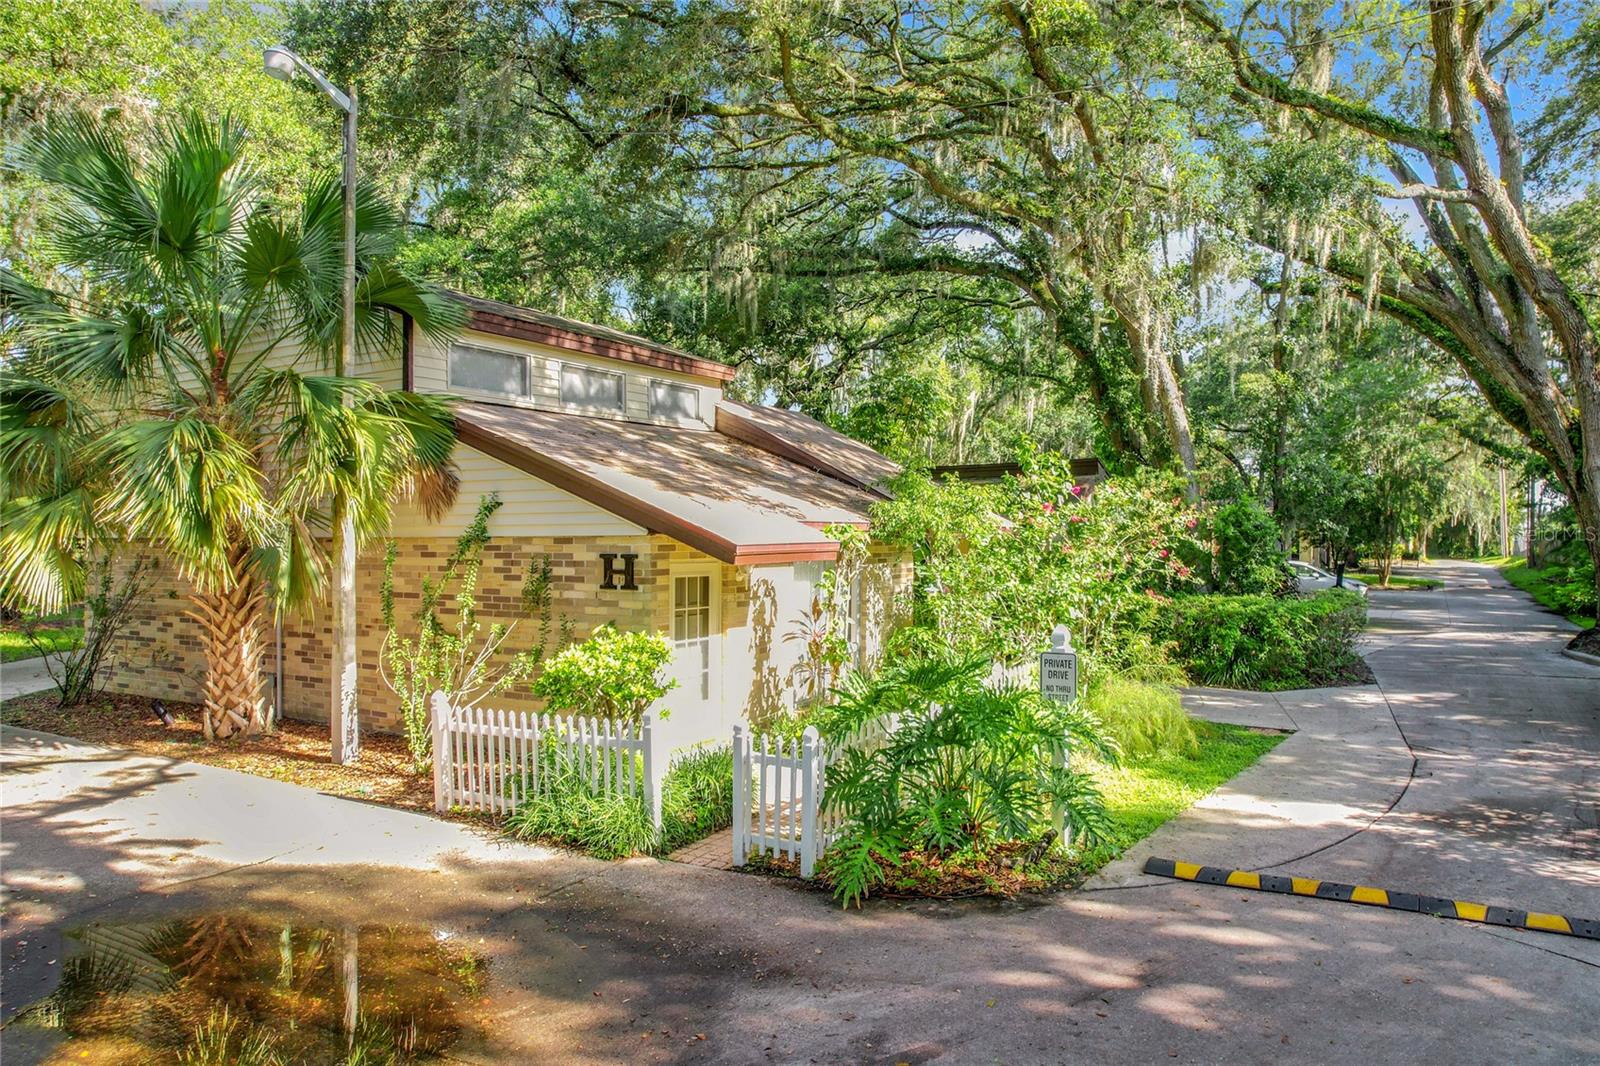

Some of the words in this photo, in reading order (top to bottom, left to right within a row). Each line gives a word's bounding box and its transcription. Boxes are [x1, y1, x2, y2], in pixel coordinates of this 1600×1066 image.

[599, 553, 638, 590] H
[1044, 658, 1072, 669] PRIVATE
[1048, 670, 1069, 680] DRIVE
[1055, 685, 1071, 694] THRU
[1048, 693, 1069, 702] STREET
